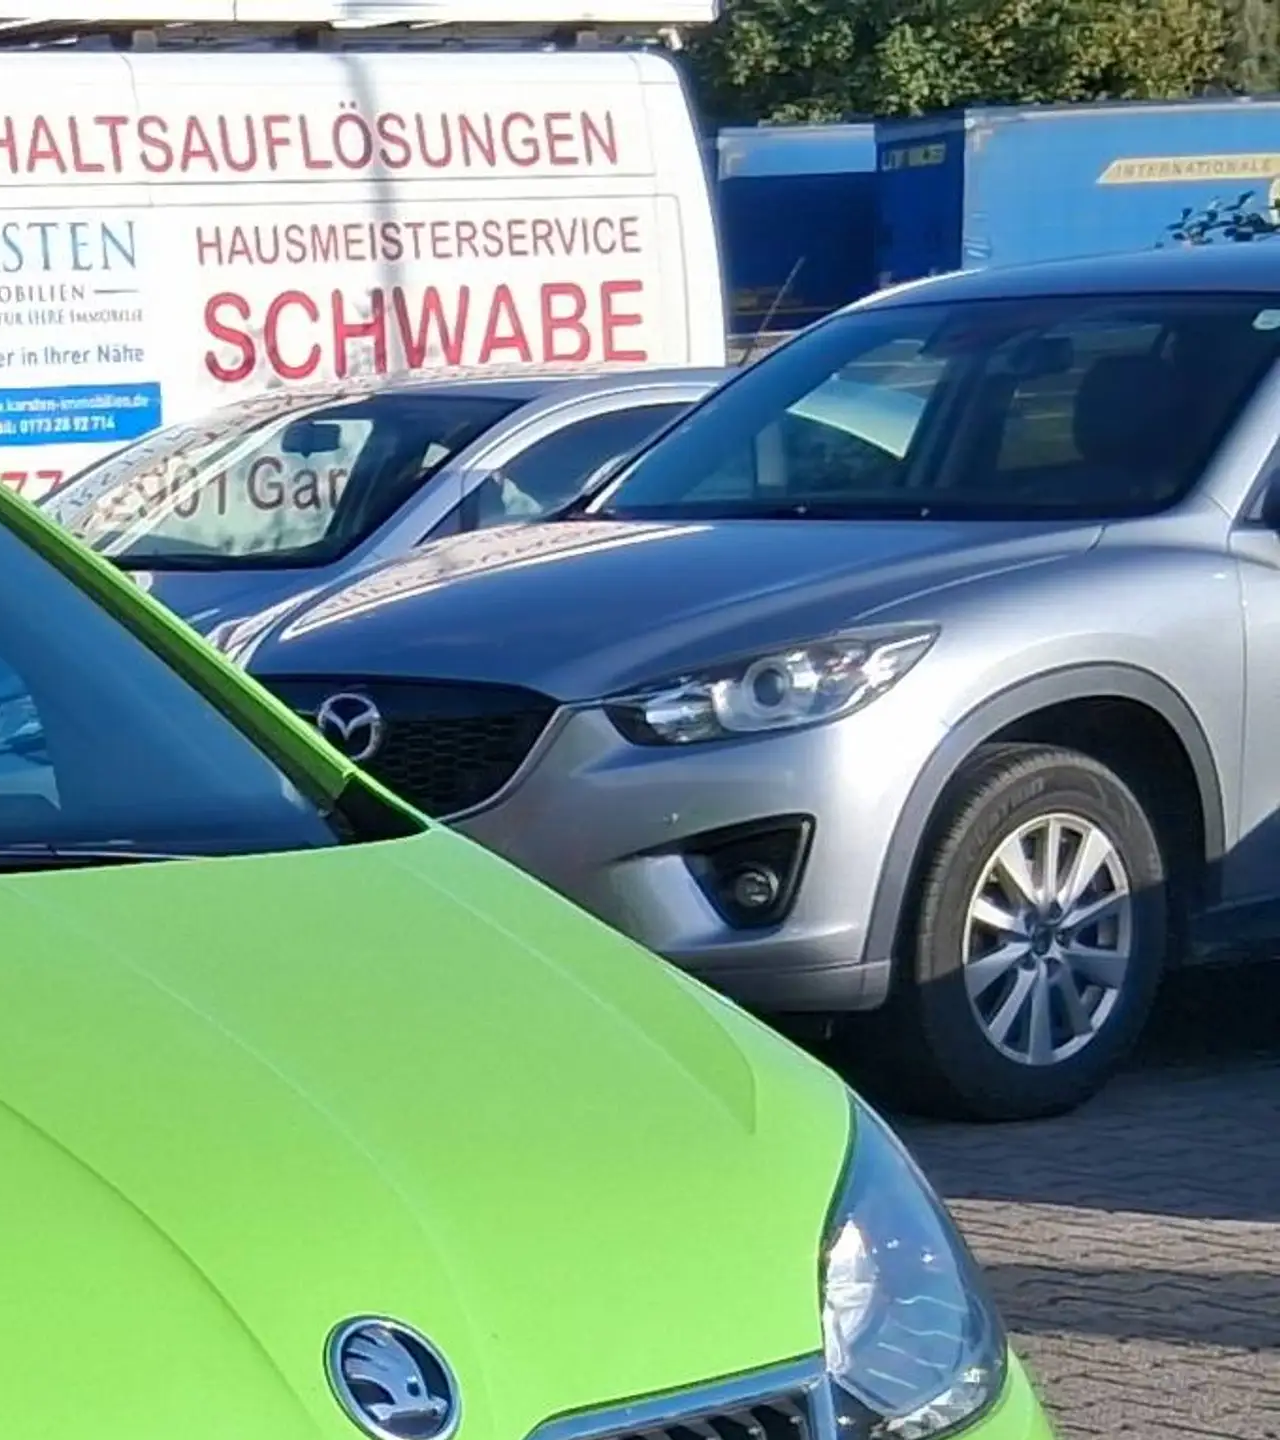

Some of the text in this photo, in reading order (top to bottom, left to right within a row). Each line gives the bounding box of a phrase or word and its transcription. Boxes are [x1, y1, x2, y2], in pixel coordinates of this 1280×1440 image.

[196, 216, 643, 266] HAUSMEISTERSERVICE
[21, 347, 38, 366] in
[44, 346, 91, 365] Ihrer
[96, 344, 146, 363] Nähe
[204, 280, 648, 382] SCHWABE
